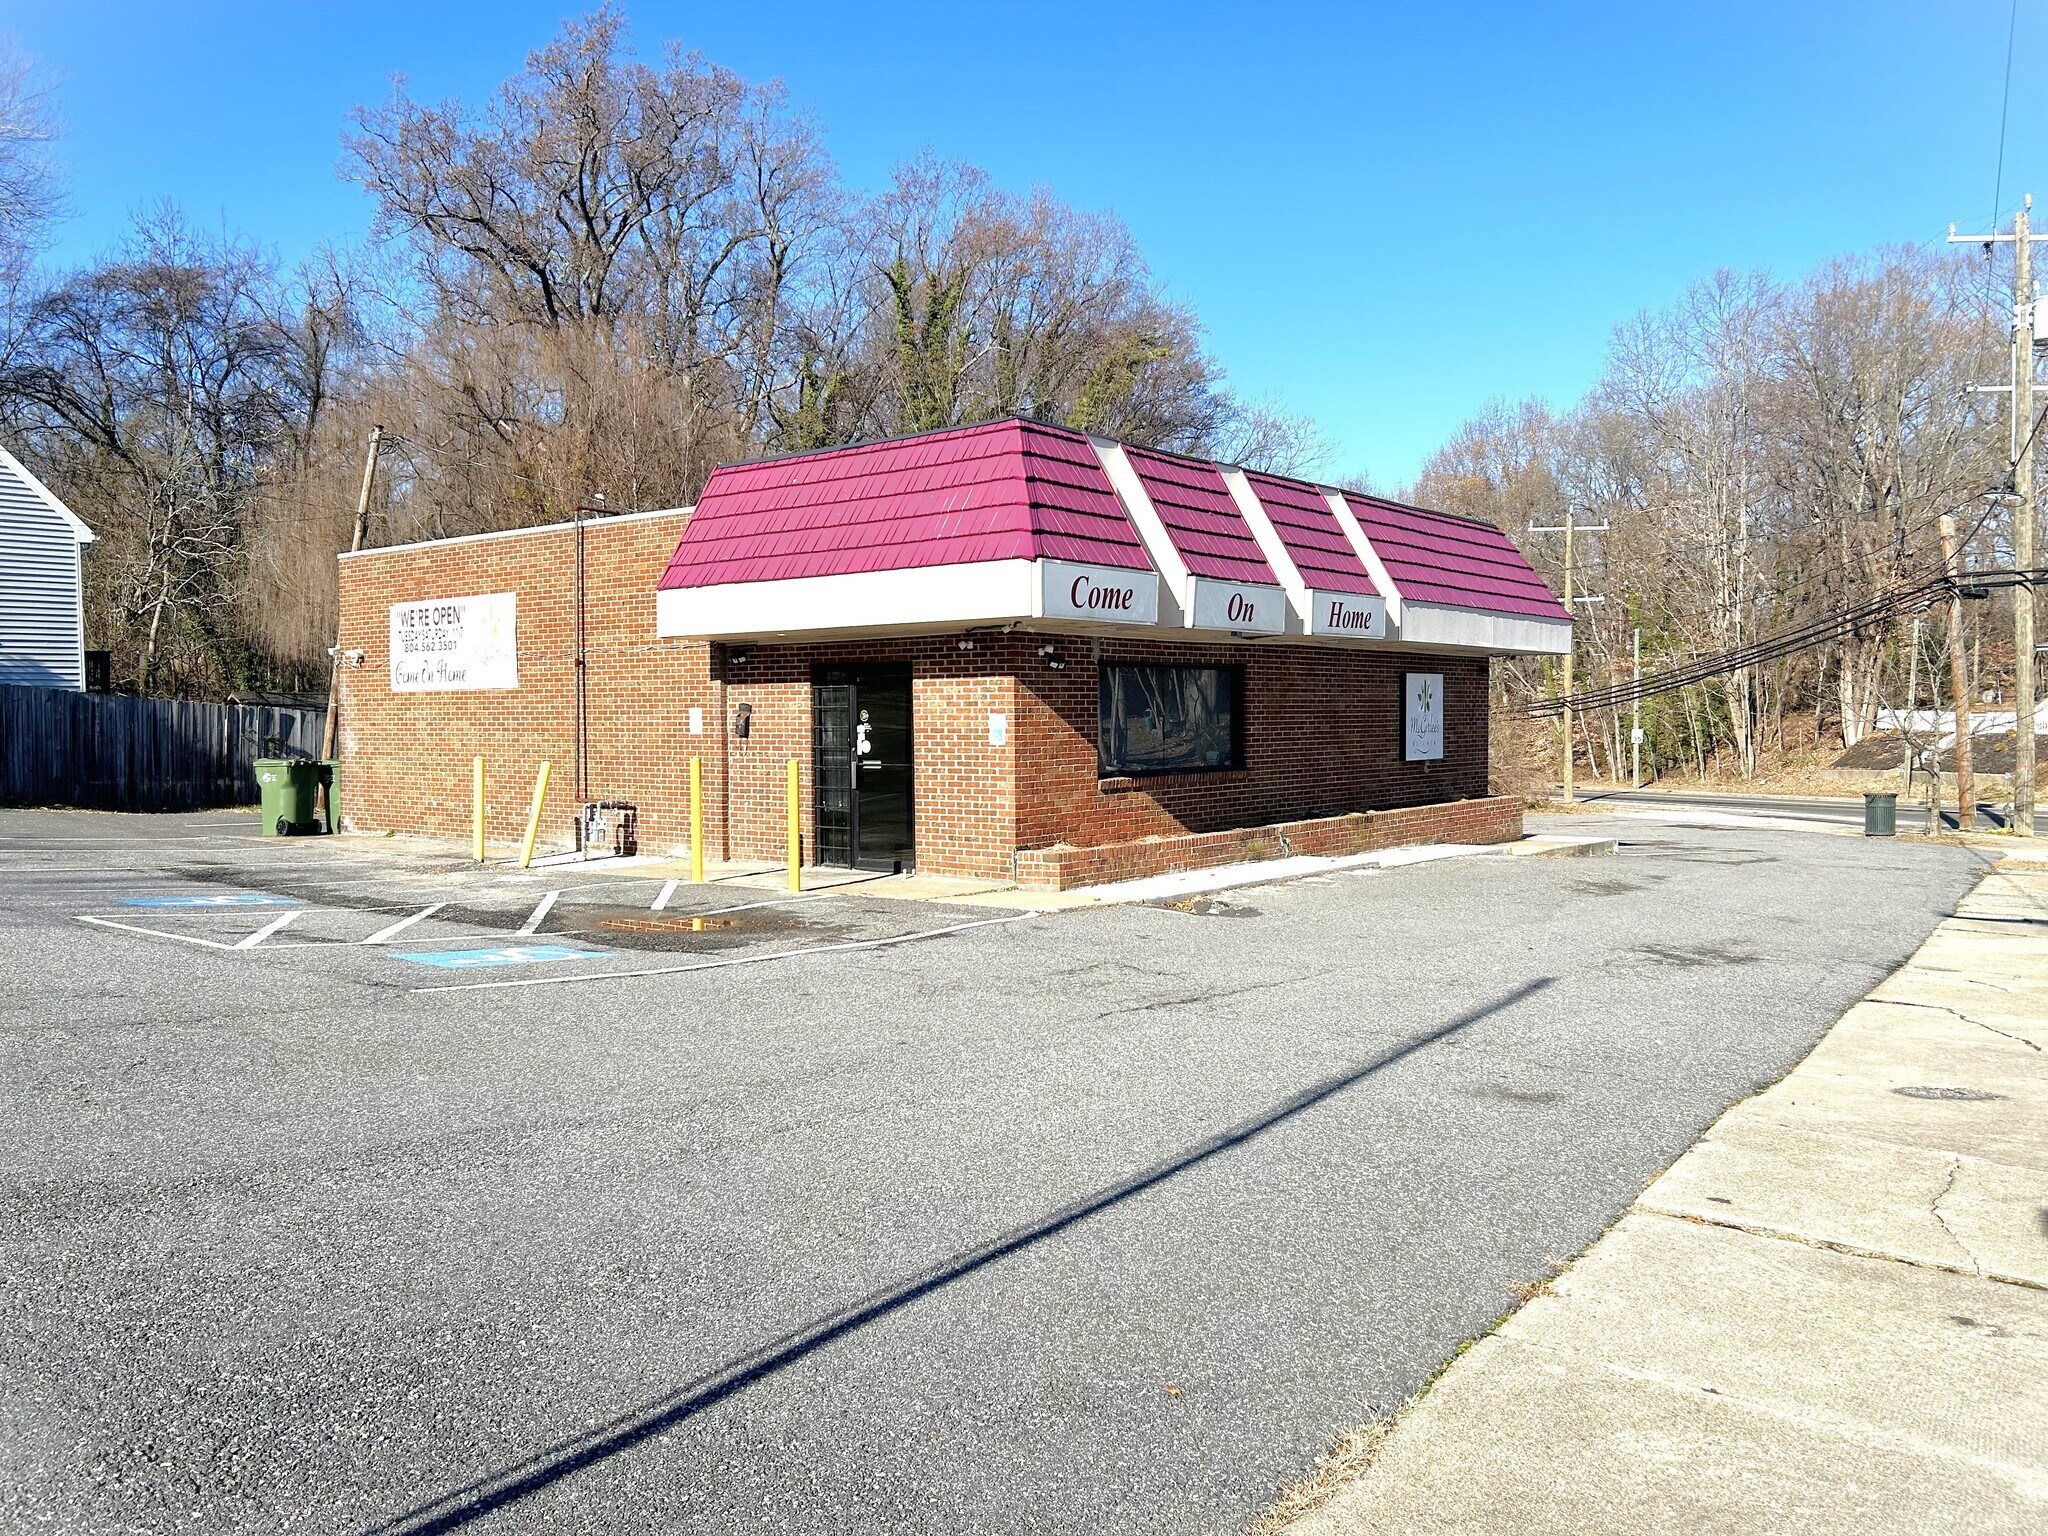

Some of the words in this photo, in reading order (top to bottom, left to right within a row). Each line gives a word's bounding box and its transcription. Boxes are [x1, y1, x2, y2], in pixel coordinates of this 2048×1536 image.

[1070, 575, 1134, 611] Come
[1227, 592, 1255, 623] On
[1328, 601, 1373, 630] Home
[404, 640, 457, 653] 804.562.3501
[436, 659, 466, 684] Home
